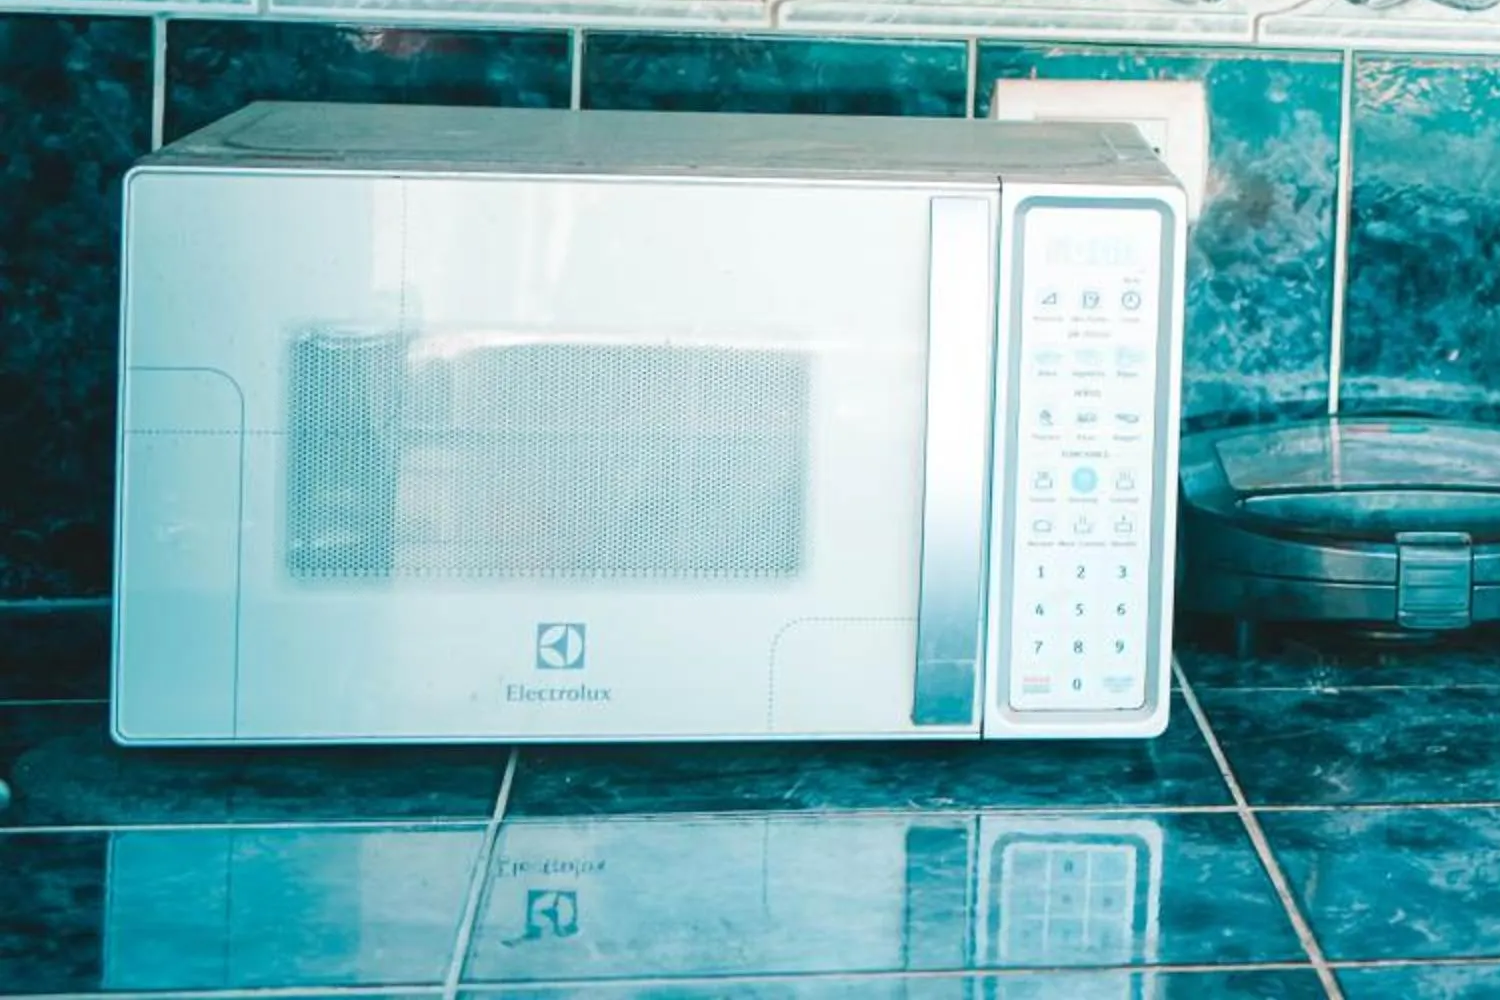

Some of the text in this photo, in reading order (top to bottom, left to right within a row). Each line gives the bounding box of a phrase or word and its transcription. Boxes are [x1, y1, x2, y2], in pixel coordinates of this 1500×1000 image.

[1077, 565, 1085, 579] 2
[1119, 565, 1127, 579] 3
[1075, 603, 1084, 616] 5
[1116, 603, 1126, 616] 6
[1034, 640, 1044, 654] 7
[1073, 640, 1084, 654] 8
[1115, 640, 1125, 654] 9
[1072, 678, 1083, 691] 0
[506, 683, 612, 702] Electrolux
